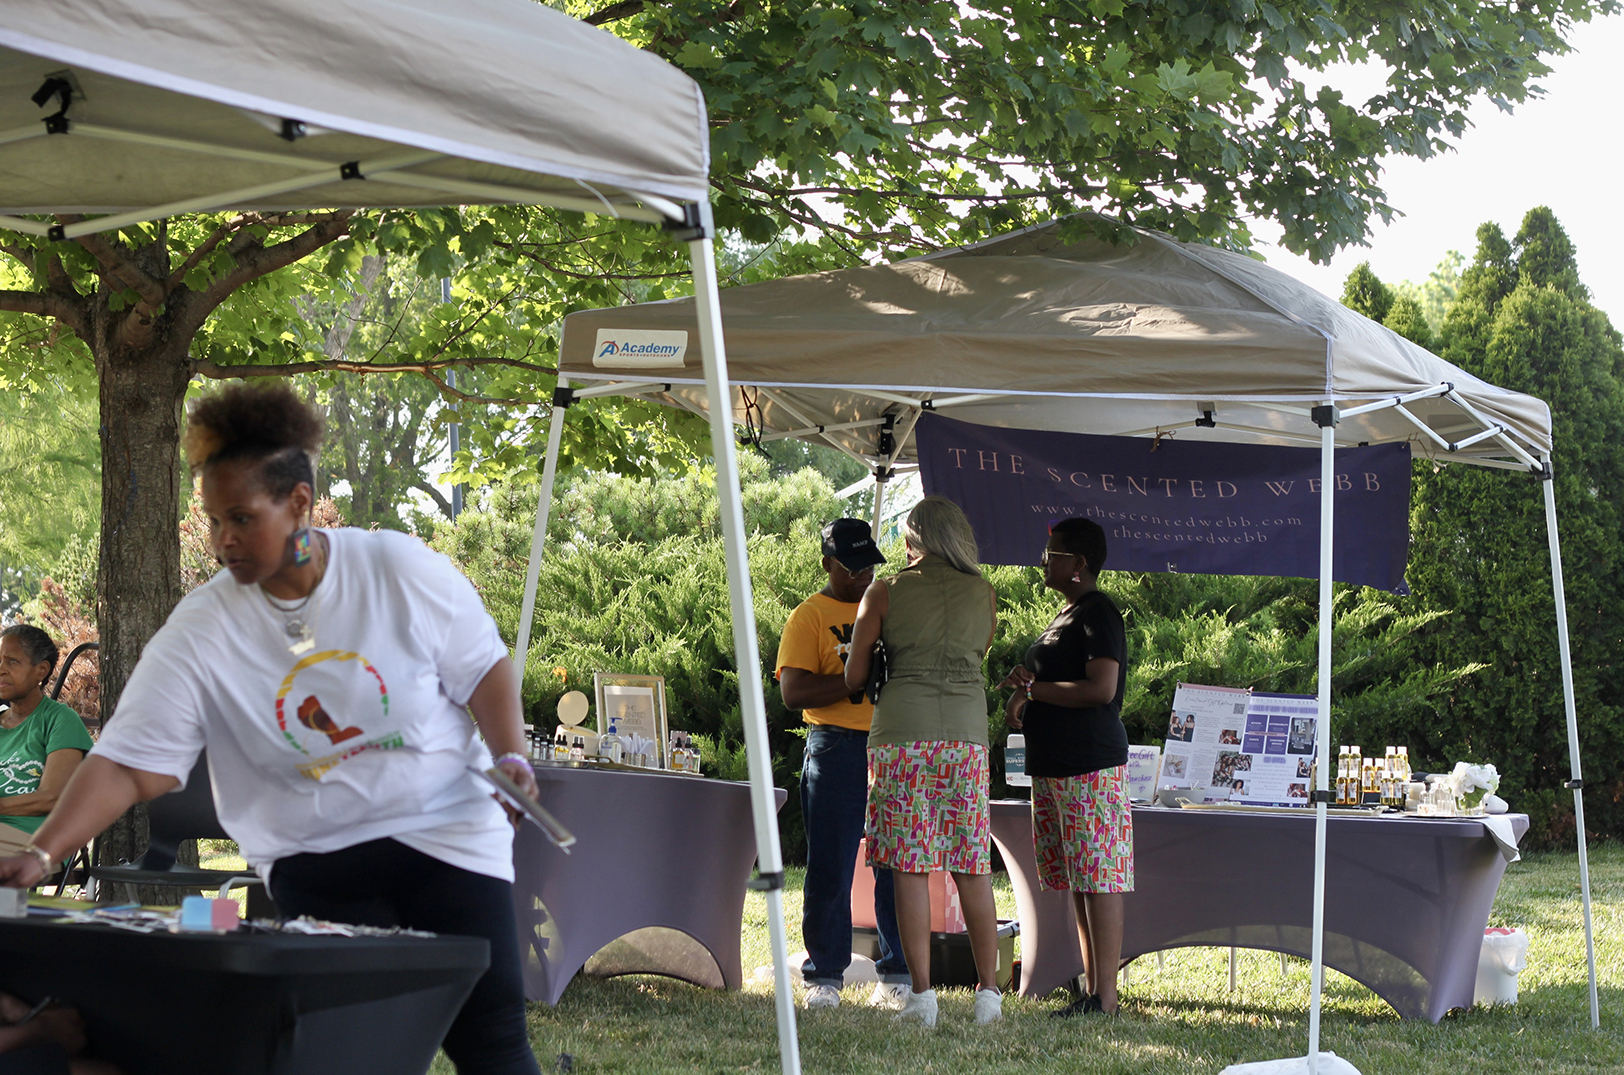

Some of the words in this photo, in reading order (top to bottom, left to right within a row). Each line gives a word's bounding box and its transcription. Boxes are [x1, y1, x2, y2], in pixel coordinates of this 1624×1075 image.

[620, 342, 680, 357] Academy
[948, 448, 1025, 475] THE
[1047, 467, 1238, 498] SCENTED
[1264, 472, 1381, 497] WEBB
[1031, 504, 1302, 528] www.thescentedwebb.com
[1114, 525, 1268, 544] thescentedwebb
